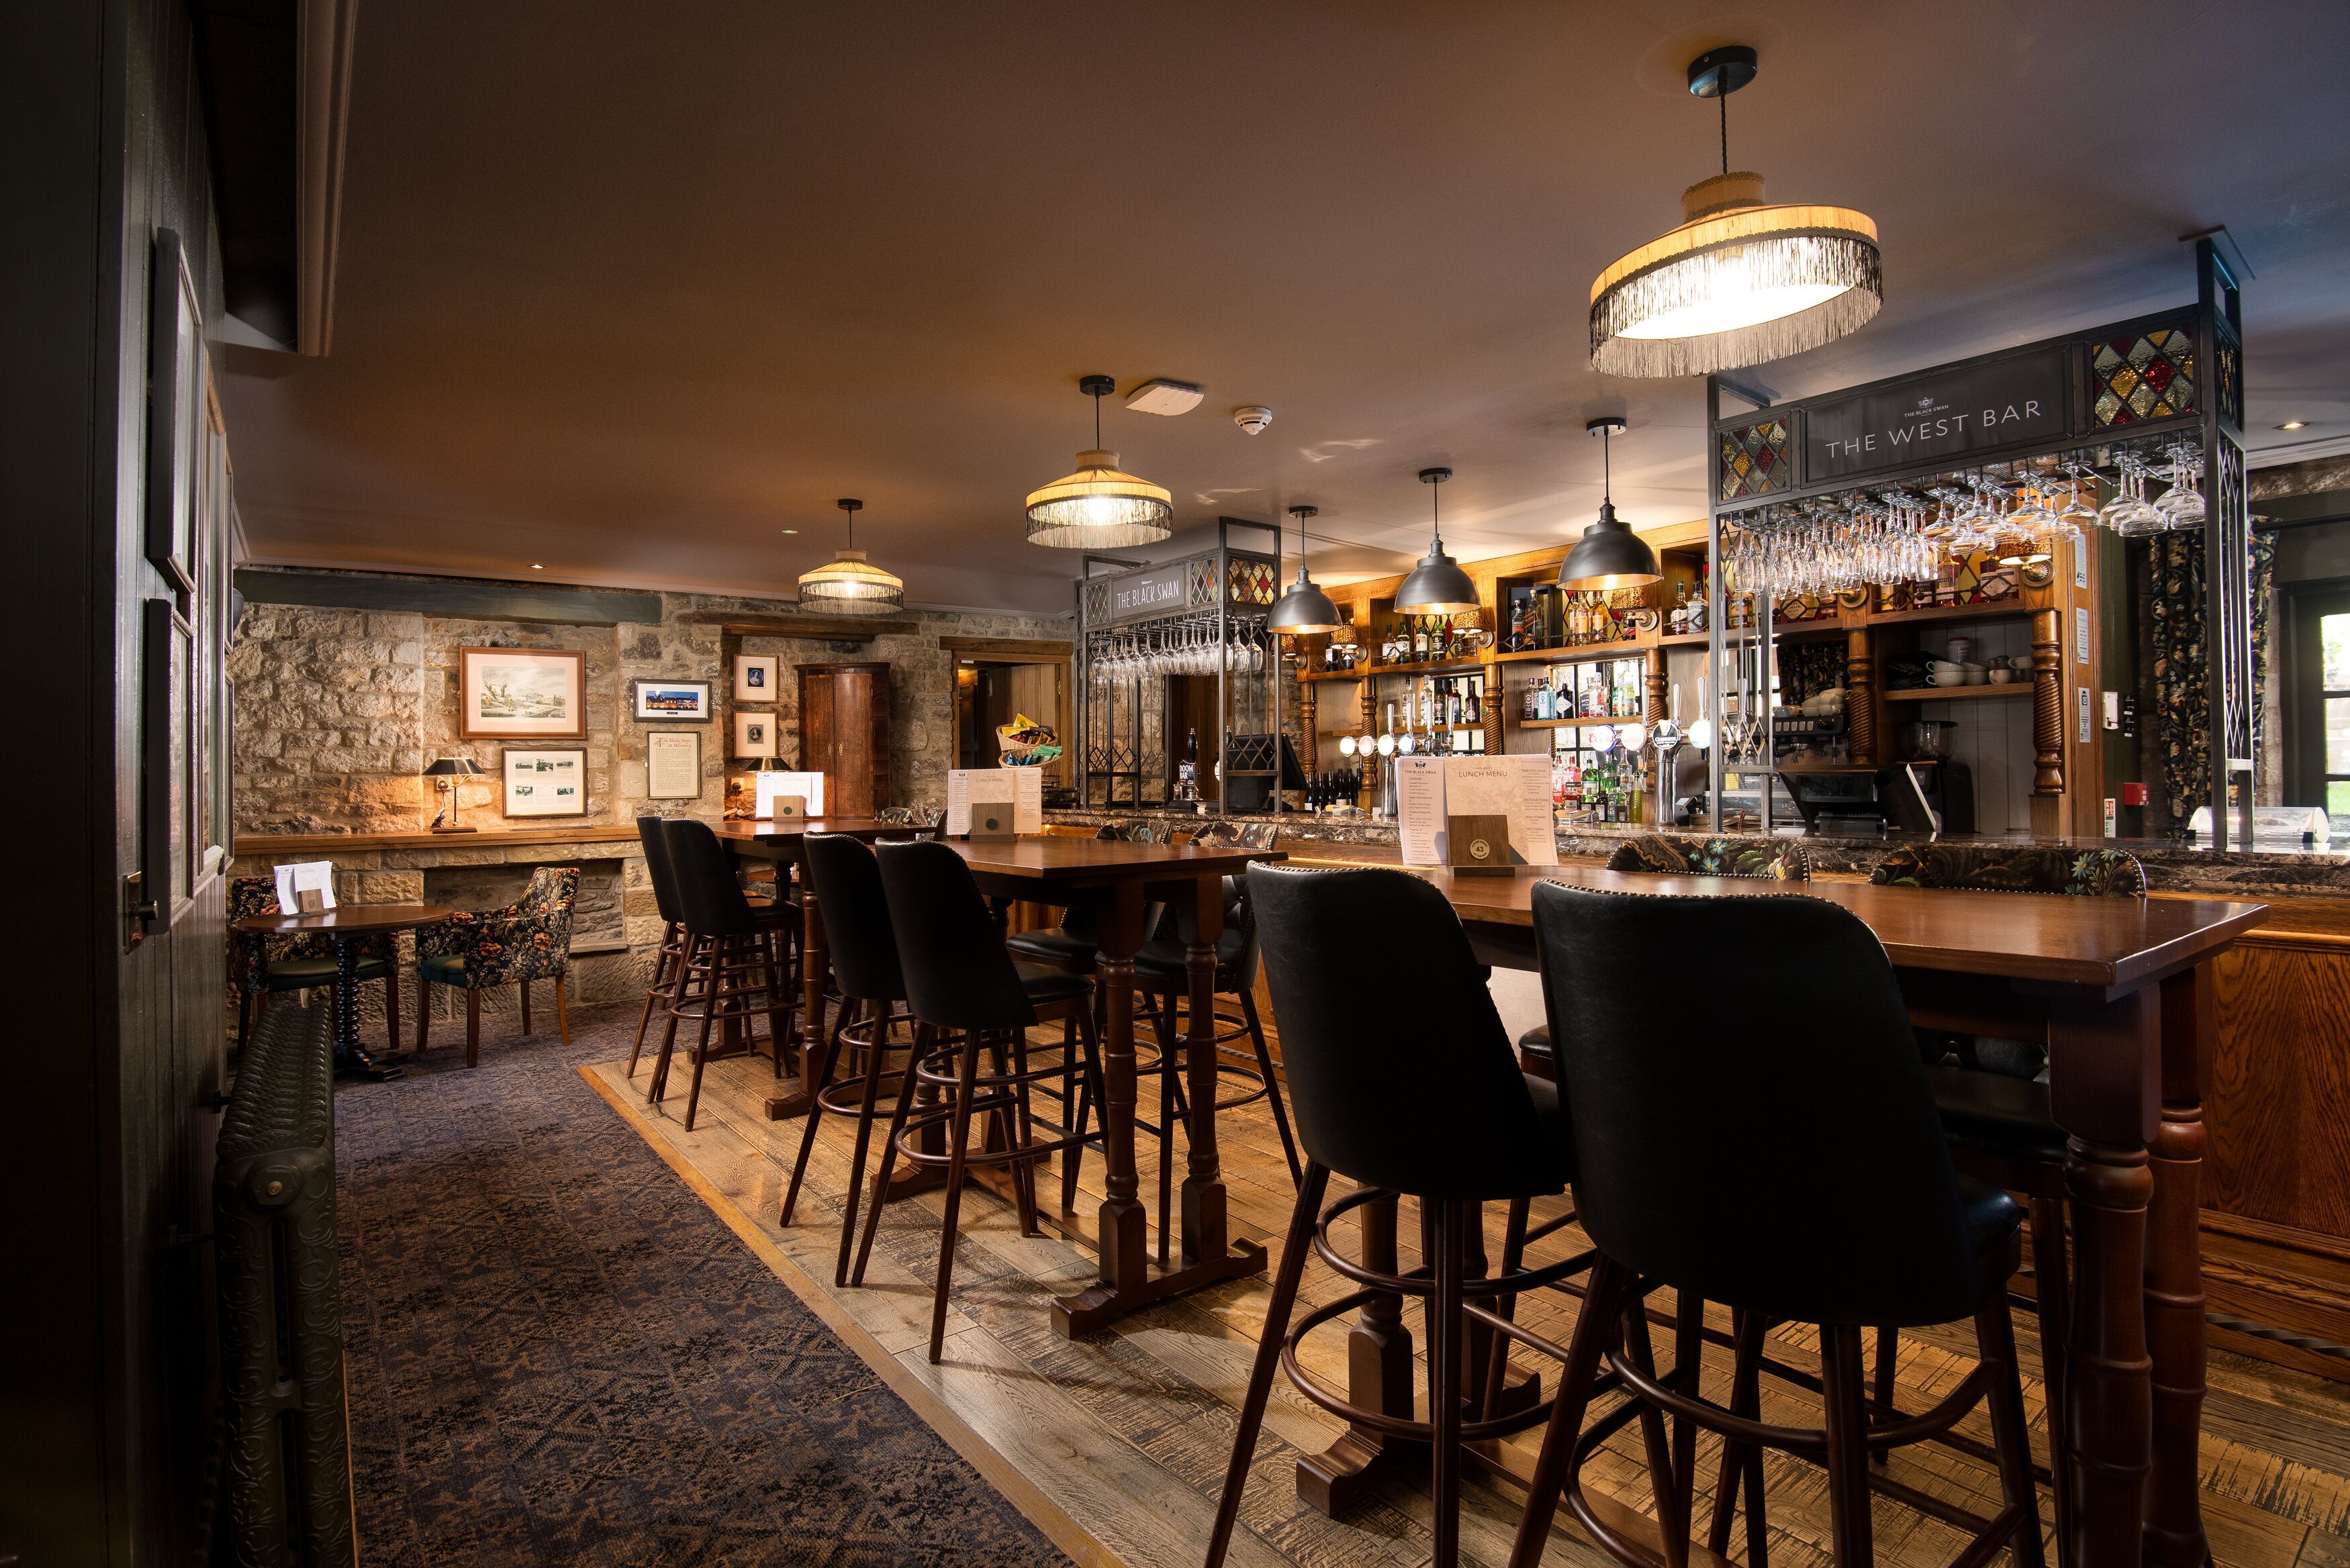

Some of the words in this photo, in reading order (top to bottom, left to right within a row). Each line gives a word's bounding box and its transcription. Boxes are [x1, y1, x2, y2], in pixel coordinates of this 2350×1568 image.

[1825, 434, 1877, 458] THE
[1888, 413, 1969, 446] WEST
[1983, 400, 2041, 427] BAR
[1117, 591, 1131, 609] THE
[1133, 586, 1155, 606] BLACK
[1157, 579, 1179, 601] SWAN
